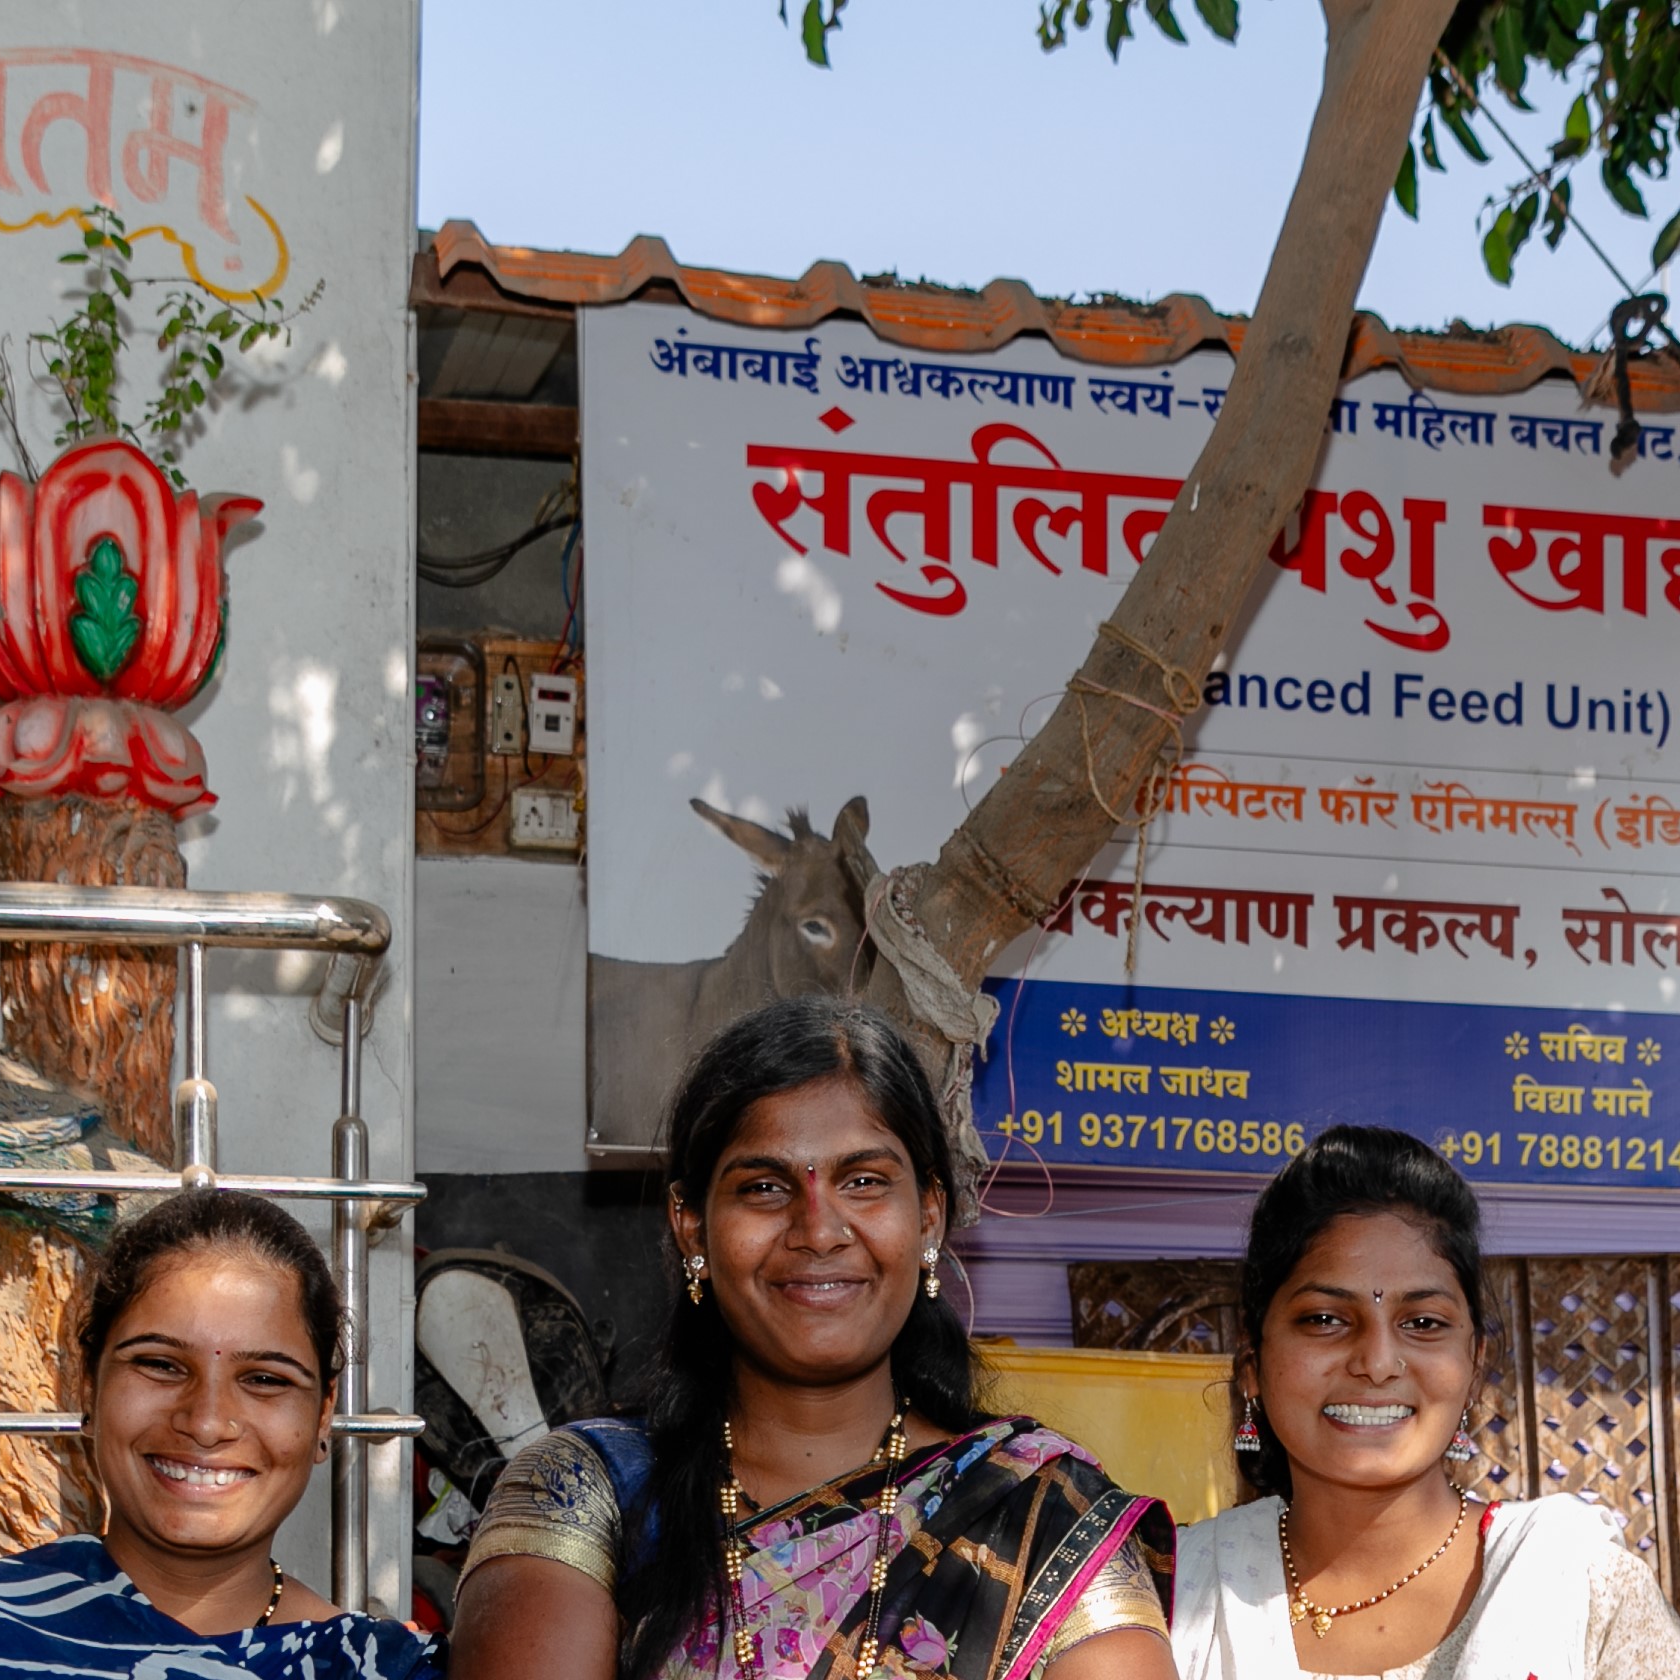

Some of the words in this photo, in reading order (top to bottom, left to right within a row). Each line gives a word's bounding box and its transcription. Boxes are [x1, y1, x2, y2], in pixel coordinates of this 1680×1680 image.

[649, 328, 821, 393] अंबाबाई
[1373, 394, 1496, 451] महिला
[1509, 412, 1604, 455] बचत
[1393, 672, 1523, 728] Feed
[1546, 684, 1671, 749] Unit)
[1319, 776, 1399, 830] फॉर
[1333, 895, 1538, 970] प्रकल्प,
[1098, 1007, 1200, 1047] अध्यक्ष
[1539, 1023, 1627, 1064] सचिव
[1055, 1060, 1151, 1095] शामल
[1159, 1065, 1251, 1100] जाधव
[1512, 1073, 1585, 1115] विद्या
[1592, 1078, 1652, 1118] माने
[997, 1109, 1063, 1146] +91
[1078, 1111, 1306, 1157] 9371768586
[1439, 1130, 1502, 1166] +91
